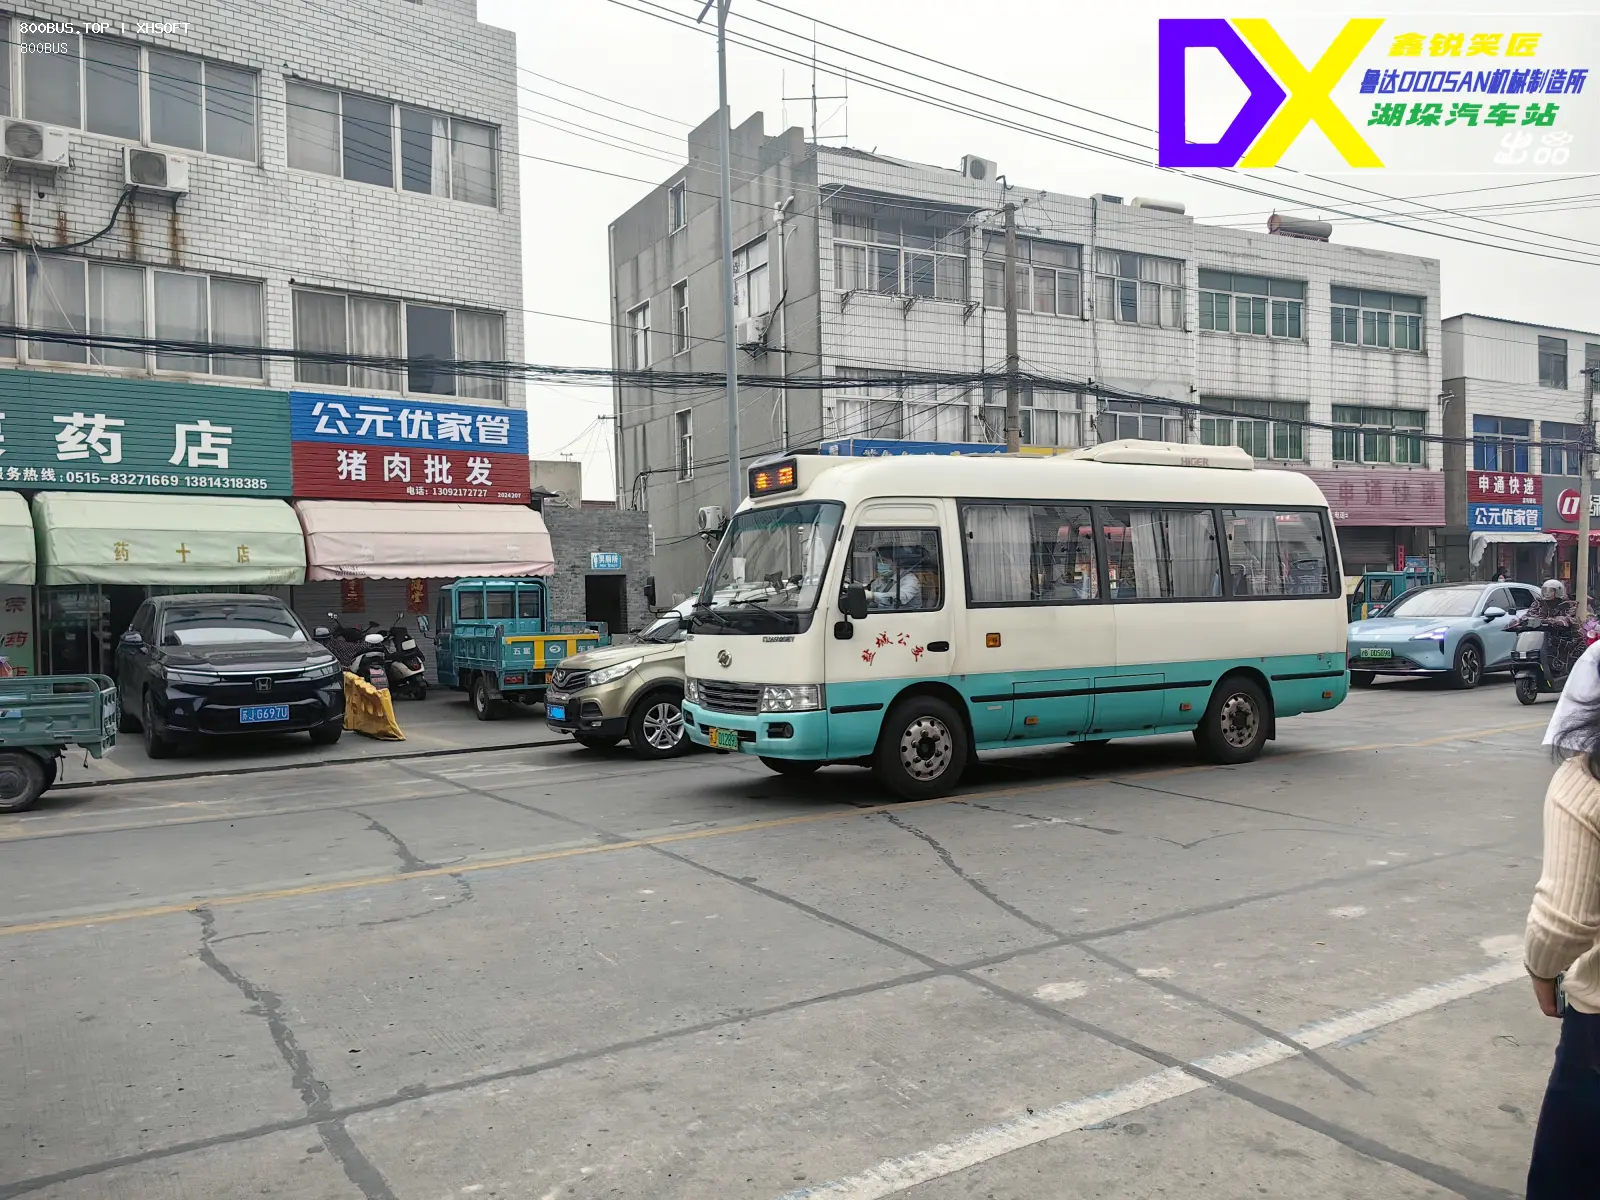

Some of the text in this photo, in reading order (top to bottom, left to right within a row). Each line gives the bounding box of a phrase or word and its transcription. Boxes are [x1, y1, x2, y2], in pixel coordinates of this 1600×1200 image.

[311, 401, 510, 445] 公元优家管
[0, 411, 233, 469] 药店
[336, 449, 493, 486] 猪肉批发
[1181, 457, 1209, 467] HIGER
[0, 466, 268, 490] 务热线:0515-83271669 13814318385
[1478, 474, 1534, 495] 申通快递
[1475, 507, 1538, 526] 公元优家管
